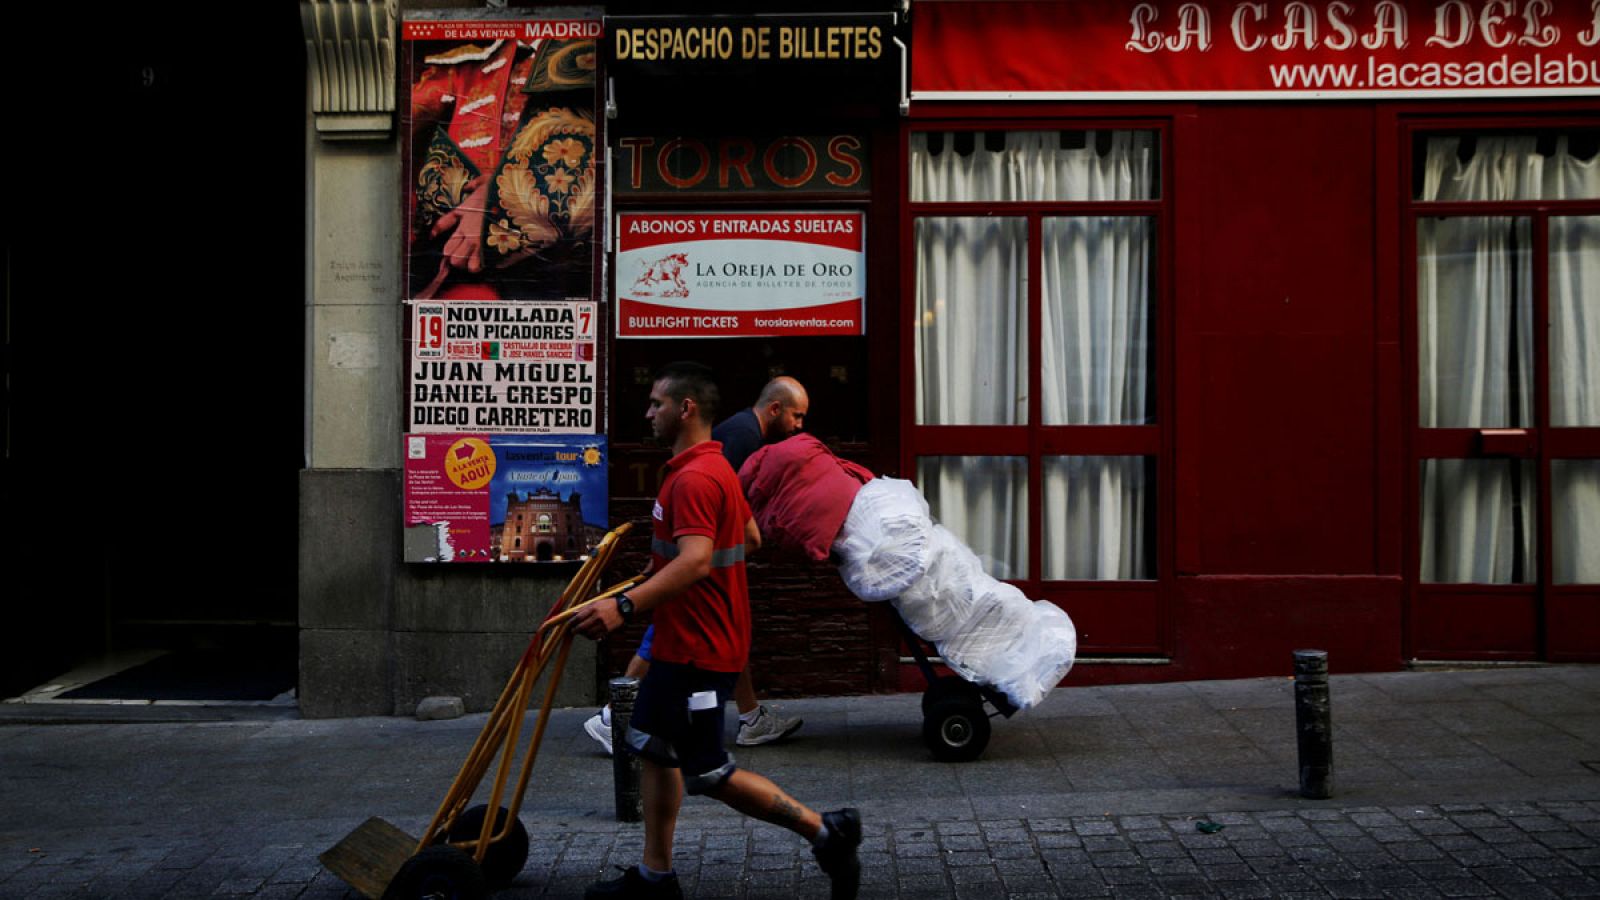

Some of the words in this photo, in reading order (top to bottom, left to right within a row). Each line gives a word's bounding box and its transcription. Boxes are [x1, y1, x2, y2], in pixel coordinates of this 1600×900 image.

[444, 29, 457, 38] DE
[460, 29, 478, 38] LAS
[479, 29, 516, 38] VENTAS
[525, 22, 601, 38] MADRID
[1125, 3, 1212, 52] LA
[1231, 1, 1408, 52] CASA
[1425, 0, 1560, 50] DEL
[616, 27, 733, 60] DESPACHO
[741, 27, 771, 60] DE
[779, 26, 883, 60] BILLETES
[142, 66, 155, 88] 9
[619, 135, 862, 190] TOROS
[629, 220, 696, 234] ABONOS
[699, 220, 710, 233] Y
[712, 220, 793, 233] ENTRADAS
[794, 219, 854, 233] SUELTAS
[696, 280, 737, 288] AGENCIA
[740, 280, 752, 288] DE
[756, 280, 801, 288] BILLETES
[804, 280, 816, 288] DE
[821, 280, 852, 288] TOROS
[447, 307, 574, 323] NOVILLADA
[580, 313, 591, 334] 7
[629, 316, 690, 329] BULLFIGHT
[693, 316, 739, 328] TICKETS
[754, 316, 854, 328] toroslasventas.com
[418, 315, 443, 349] 19
[446, 324, 479, 339] CON
[484, 325, 574, 340] PICADORES
[415, 362, 483, 381] JUAN
[495, 363, 592, 383] MIGUEL
[414, 383, 498, 403] DANIEL
[507, 386, 592, 405] CRESPO
[414, 406, 469, 425] DIEGO
[475, 407, 592, 427] CARRETERO
[467, 455, 489, 466] VENTA
[537, 471, 549, 484] of
